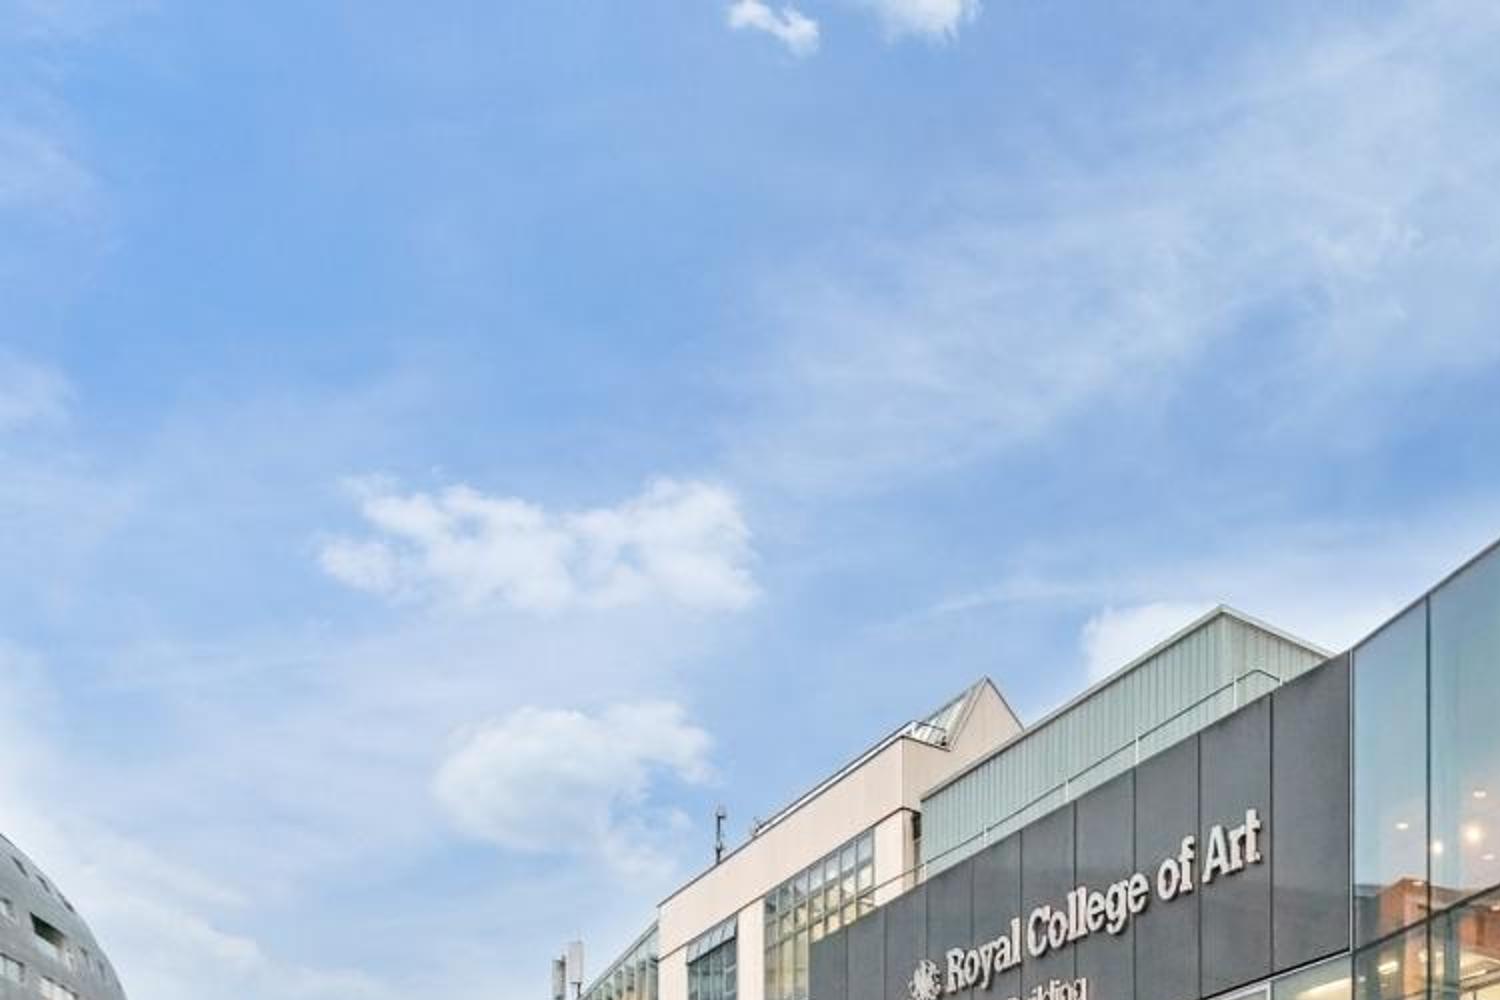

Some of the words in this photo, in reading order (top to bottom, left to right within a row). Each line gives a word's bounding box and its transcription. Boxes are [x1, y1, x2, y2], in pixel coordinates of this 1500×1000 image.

[945, 918, 1022, 993] Royal
[1027, 872, 1149, 957] College
[1157, 835, 1196, 901] of
[1202, 809, 1263, 884] Art
